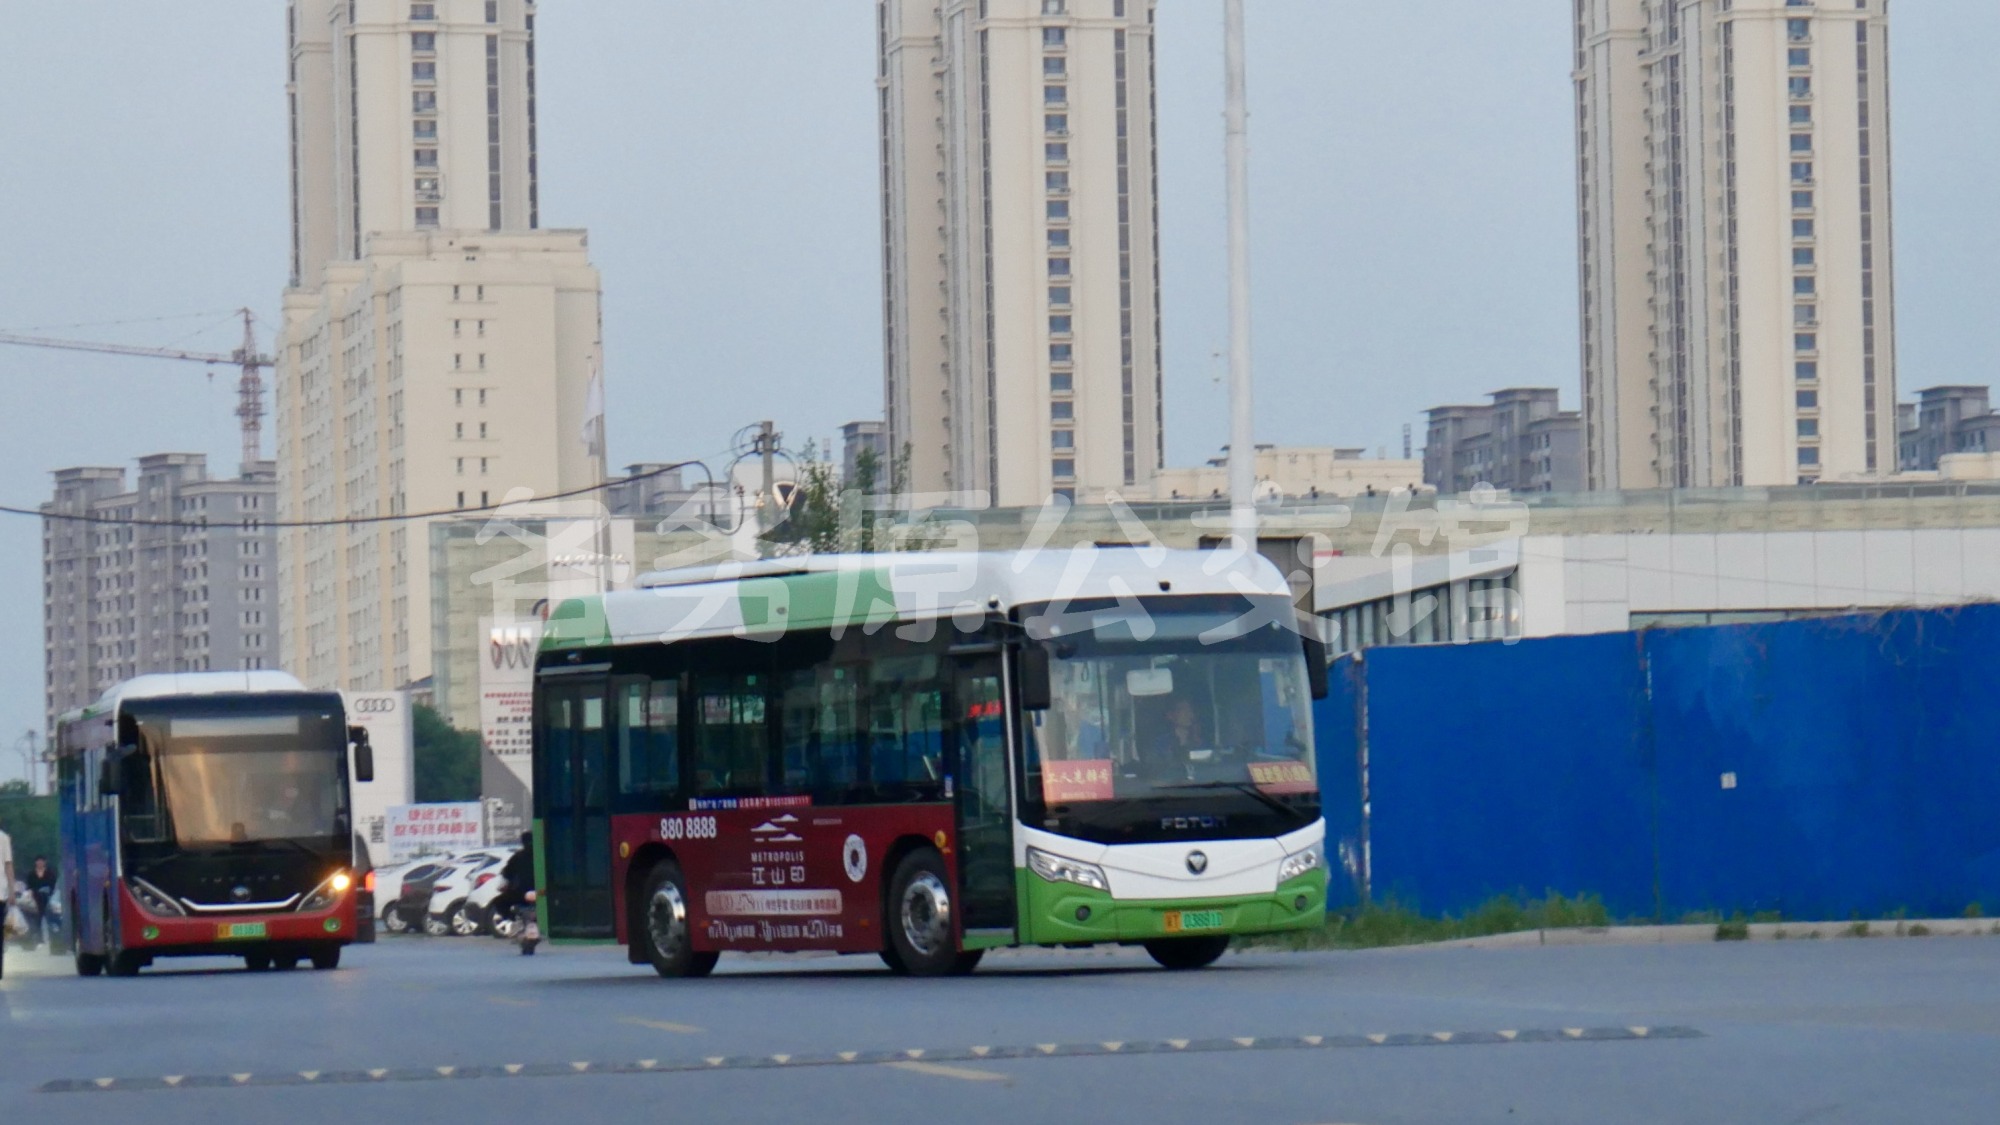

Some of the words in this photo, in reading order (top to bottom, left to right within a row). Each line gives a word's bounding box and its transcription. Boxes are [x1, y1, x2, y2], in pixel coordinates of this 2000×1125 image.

[661, 817, 683, 839] 880
[686, 816, 716, 838] 8888
[1162, 817, 1228, 830] FOTON
[751, 851, 804, 863] METROPOLIS
